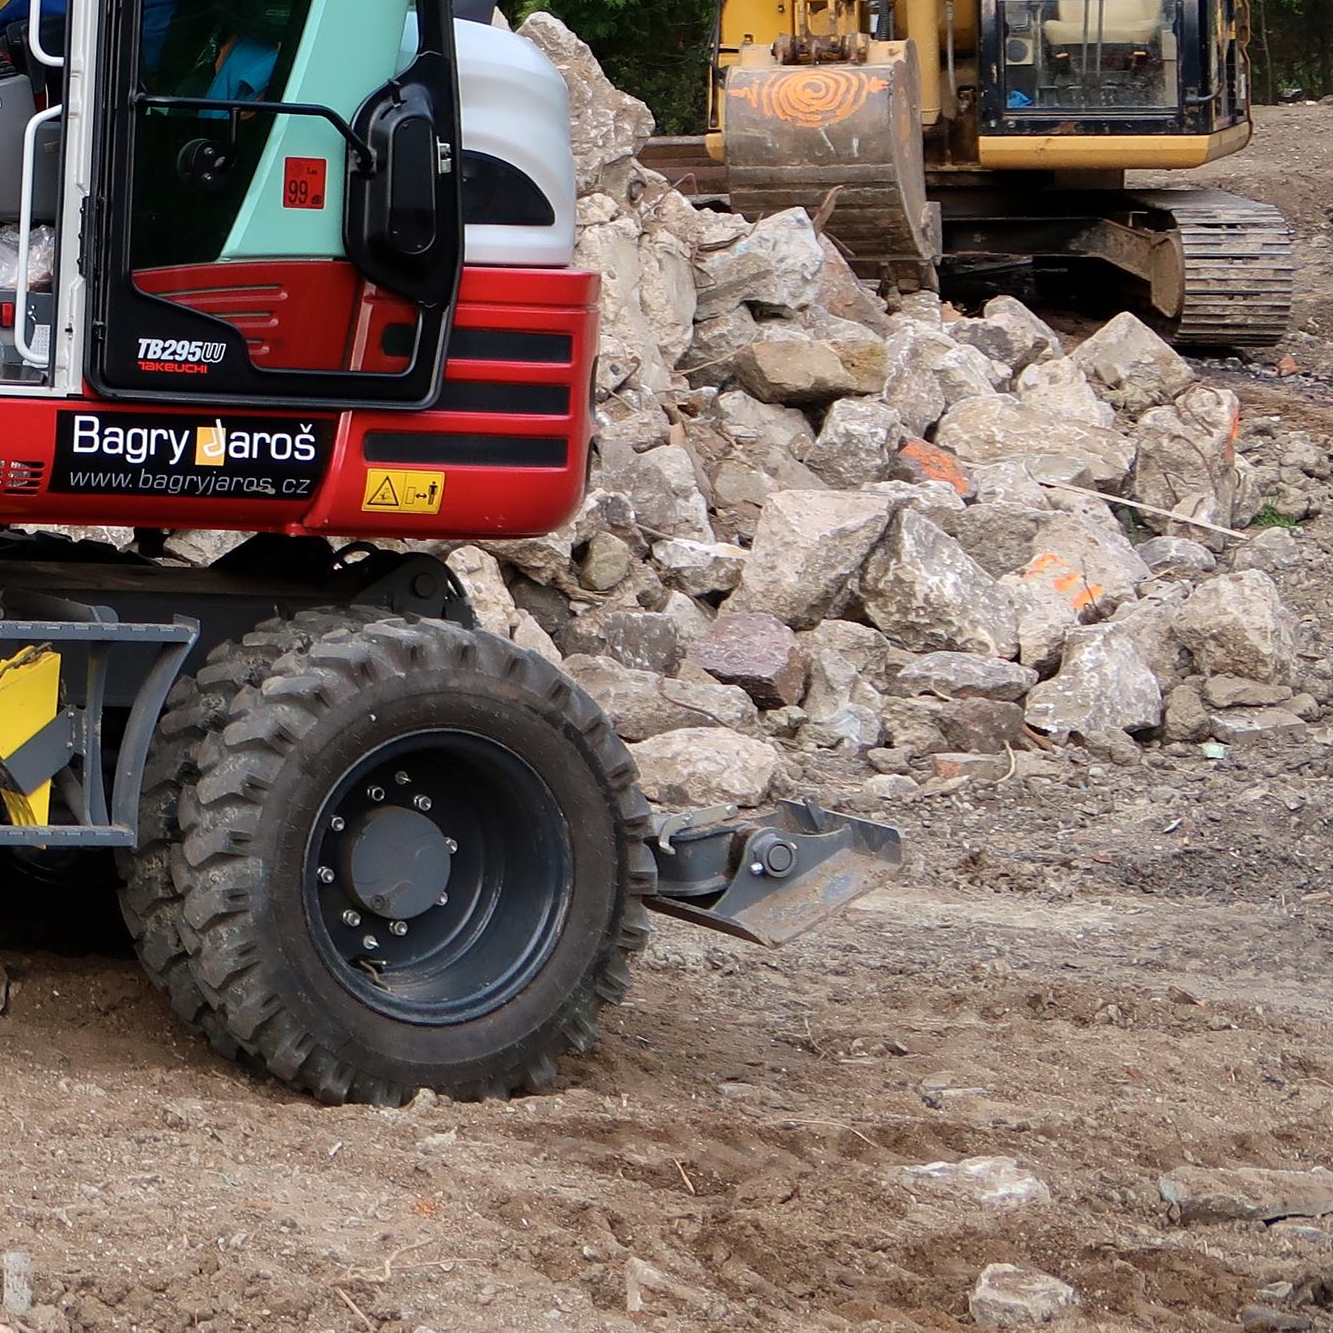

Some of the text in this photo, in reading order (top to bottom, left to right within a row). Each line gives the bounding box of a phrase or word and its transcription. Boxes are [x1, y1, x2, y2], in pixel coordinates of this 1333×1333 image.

[288, 179, 309, 204] 99
[137, 338, 227, 364] TB295W
[137, 361, 208, 374] TAKEUCHI
[72, 415, 316, 465] Bagry Jaroš
[69, 469, 311, 495] www.bagryjaroscz
